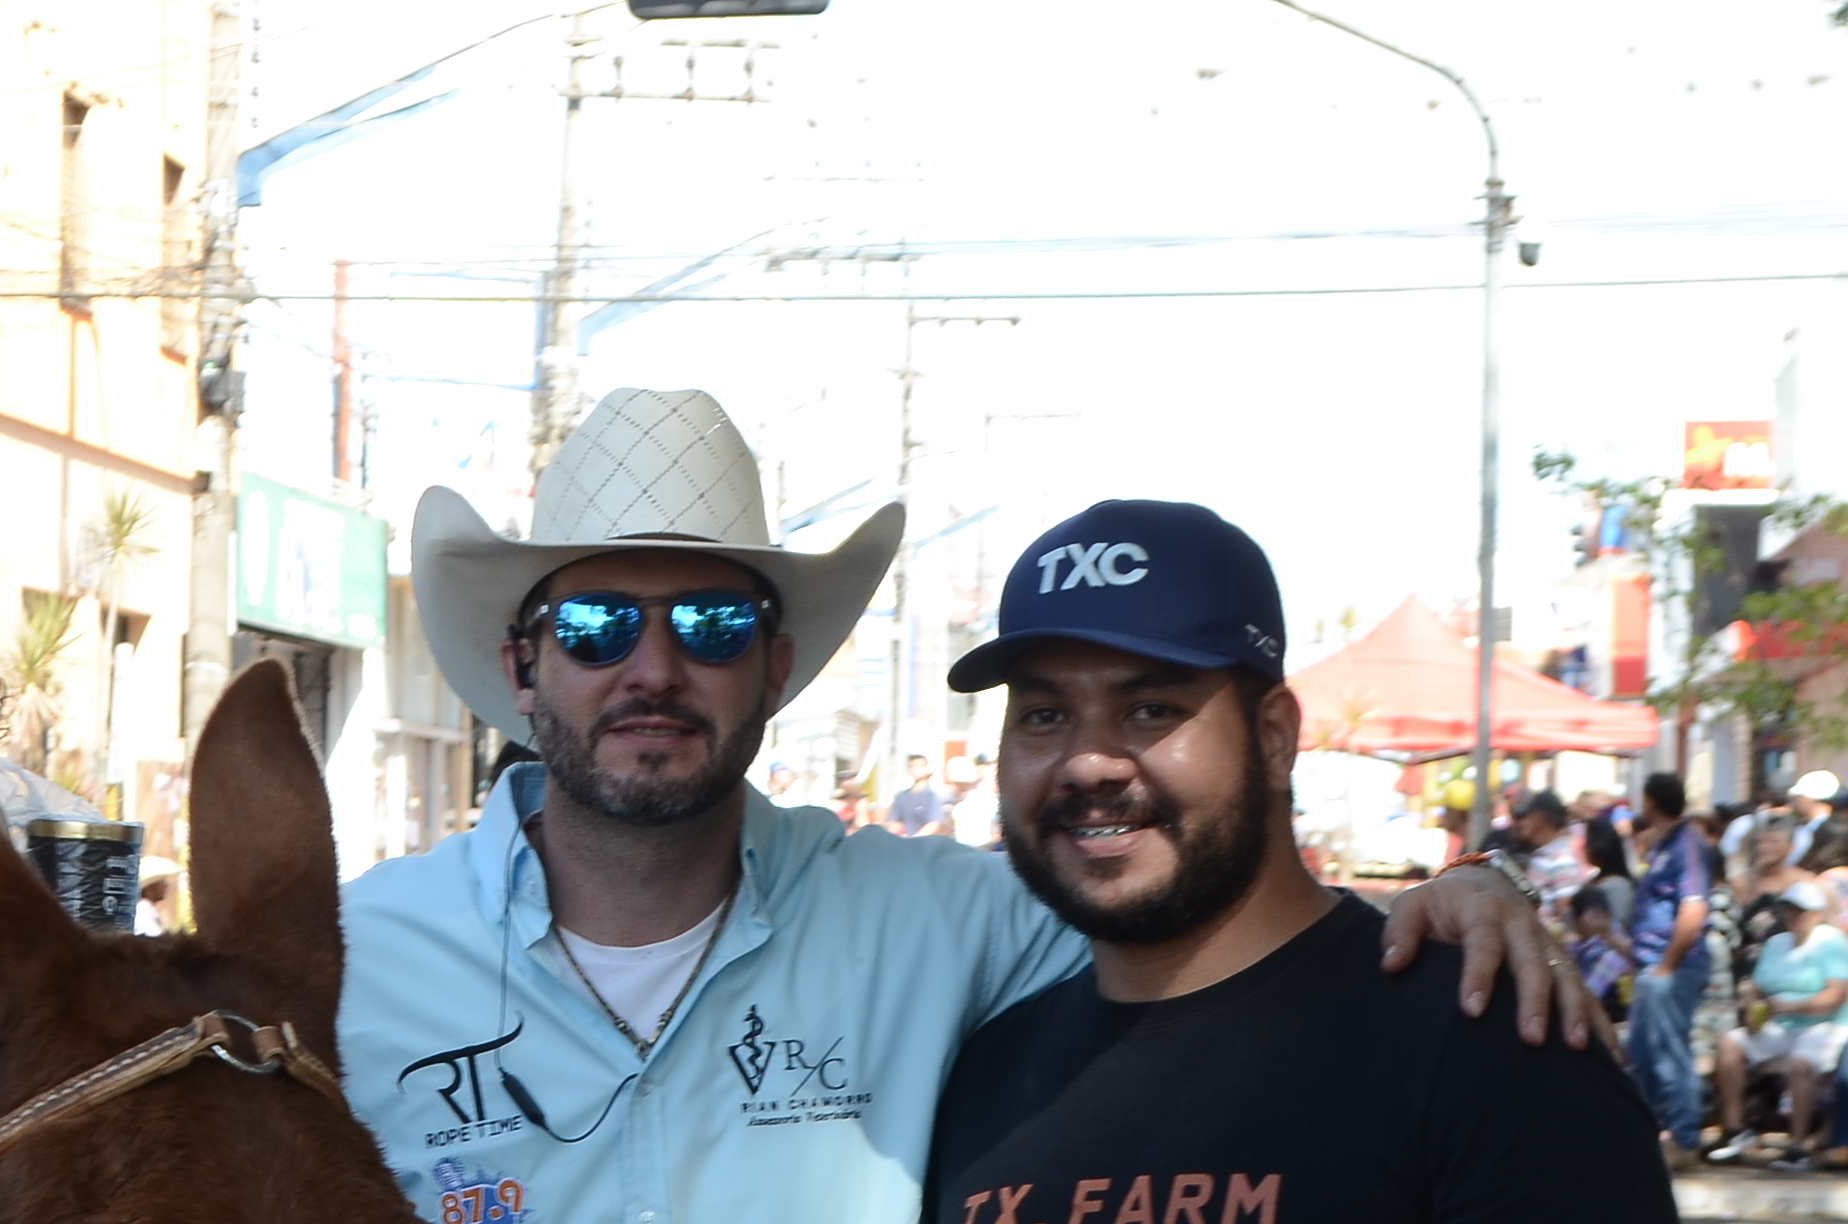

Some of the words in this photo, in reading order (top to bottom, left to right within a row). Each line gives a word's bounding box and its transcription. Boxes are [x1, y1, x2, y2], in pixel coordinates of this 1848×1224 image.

[1037, 542, 1149, 594] TXC
[1245, 623, 1279, 659] TXC
[425, 1126, 472, 1149] ROPE
[474, 1114, 523, 1138] TIME
